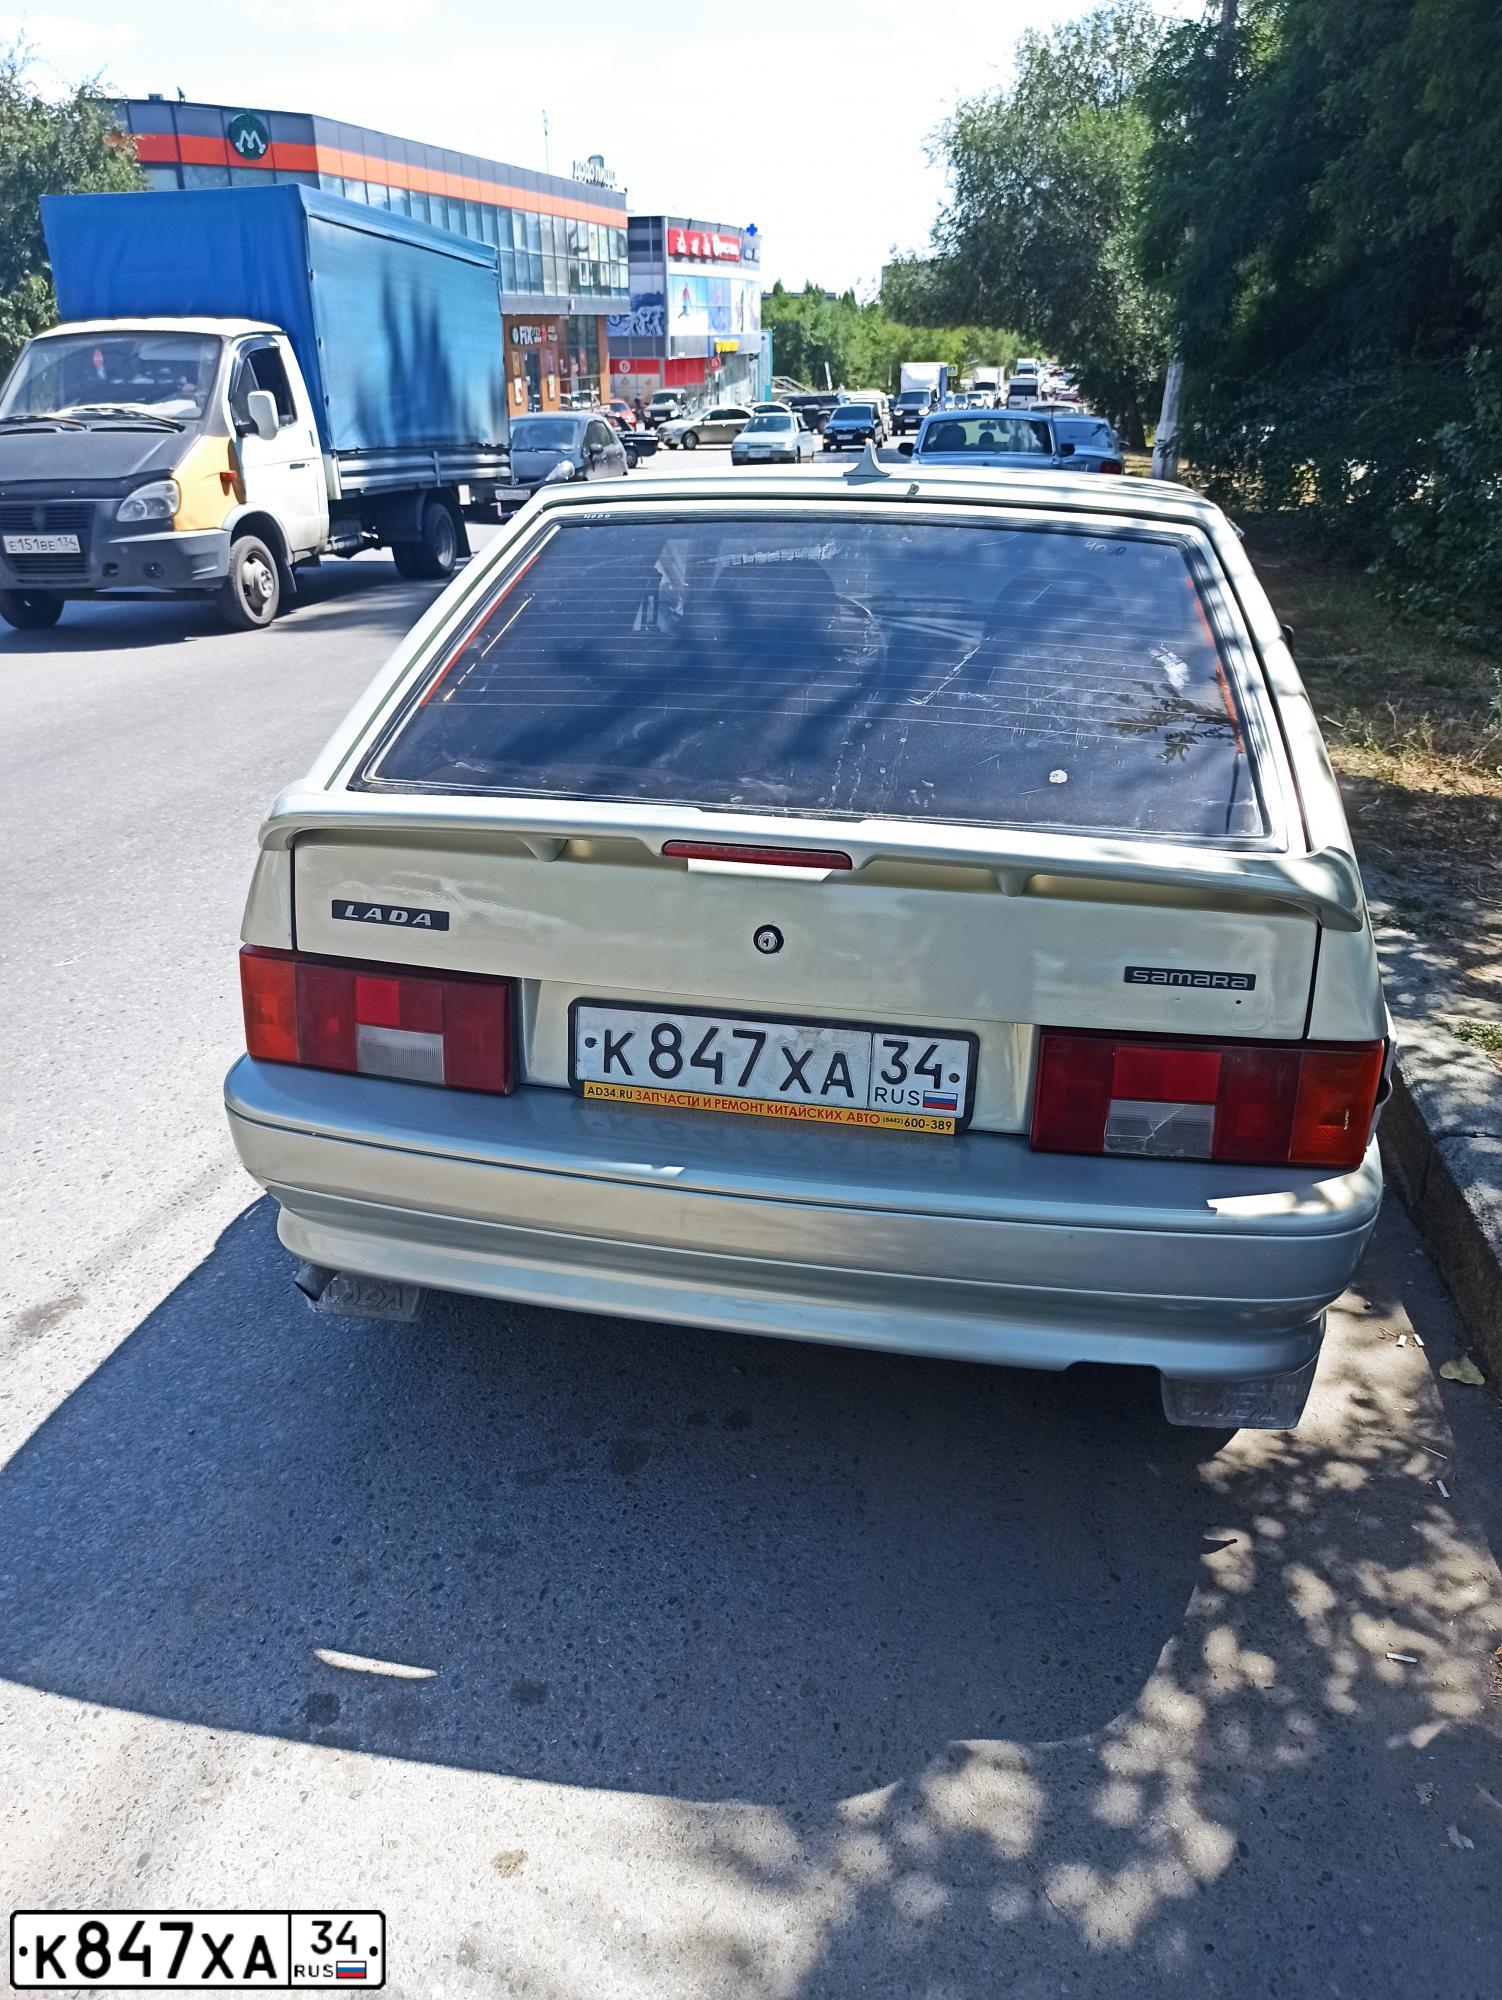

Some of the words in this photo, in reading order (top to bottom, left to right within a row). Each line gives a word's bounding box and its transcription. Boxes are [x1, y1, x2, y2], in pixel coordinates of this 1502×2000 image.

[344, 905, 432, 926] LADA
[880, 1040, 942, 1090] 34
[587, 1086, 633, 1099] AD34.RU
[635, 1092, 700, 1107] ЗАПЧАСТИ
[703, 1097, 711, 1108] И
[714, 1099, 764, 1113] РЕМОНТ
[767, 1104, 842, 1120] КИТАЙСКИХ
[846, 1111, 881, 1124] АВТО
[882, 1116, 904, 1125] (8442)
[904, 1118, 952, 1131] 600-389
[874, 1086, 920, 1106] RUS
